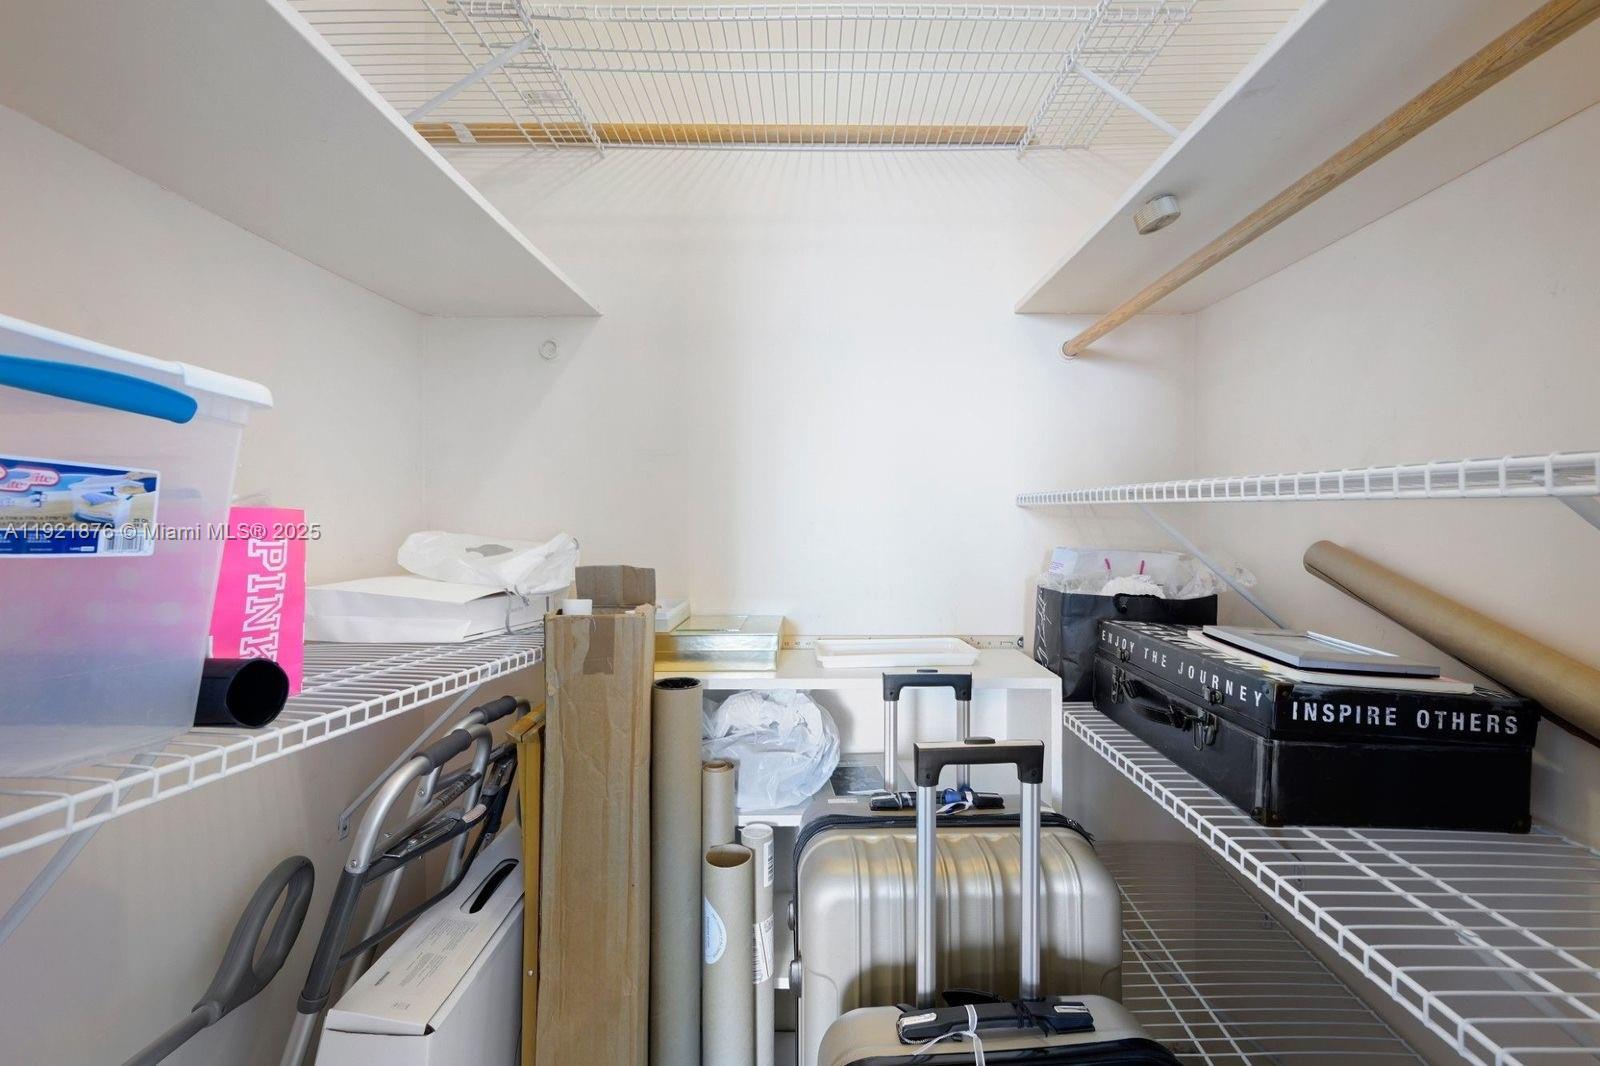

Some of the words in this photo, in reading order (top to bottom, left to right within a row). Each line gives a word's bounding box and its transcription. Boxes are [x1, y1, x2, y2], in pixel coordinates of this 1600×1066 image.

[240, 538, 289, 663] PINK
[1101, 629, 1135, 653] ENJOY
[1144, 648, 1168, 669] THE
[1177, 661, 1264, 708] JOURNEY
[1292, 701, 1398, 726] INSPIRE
[1416, 709, 1519, 735] OTHERS
